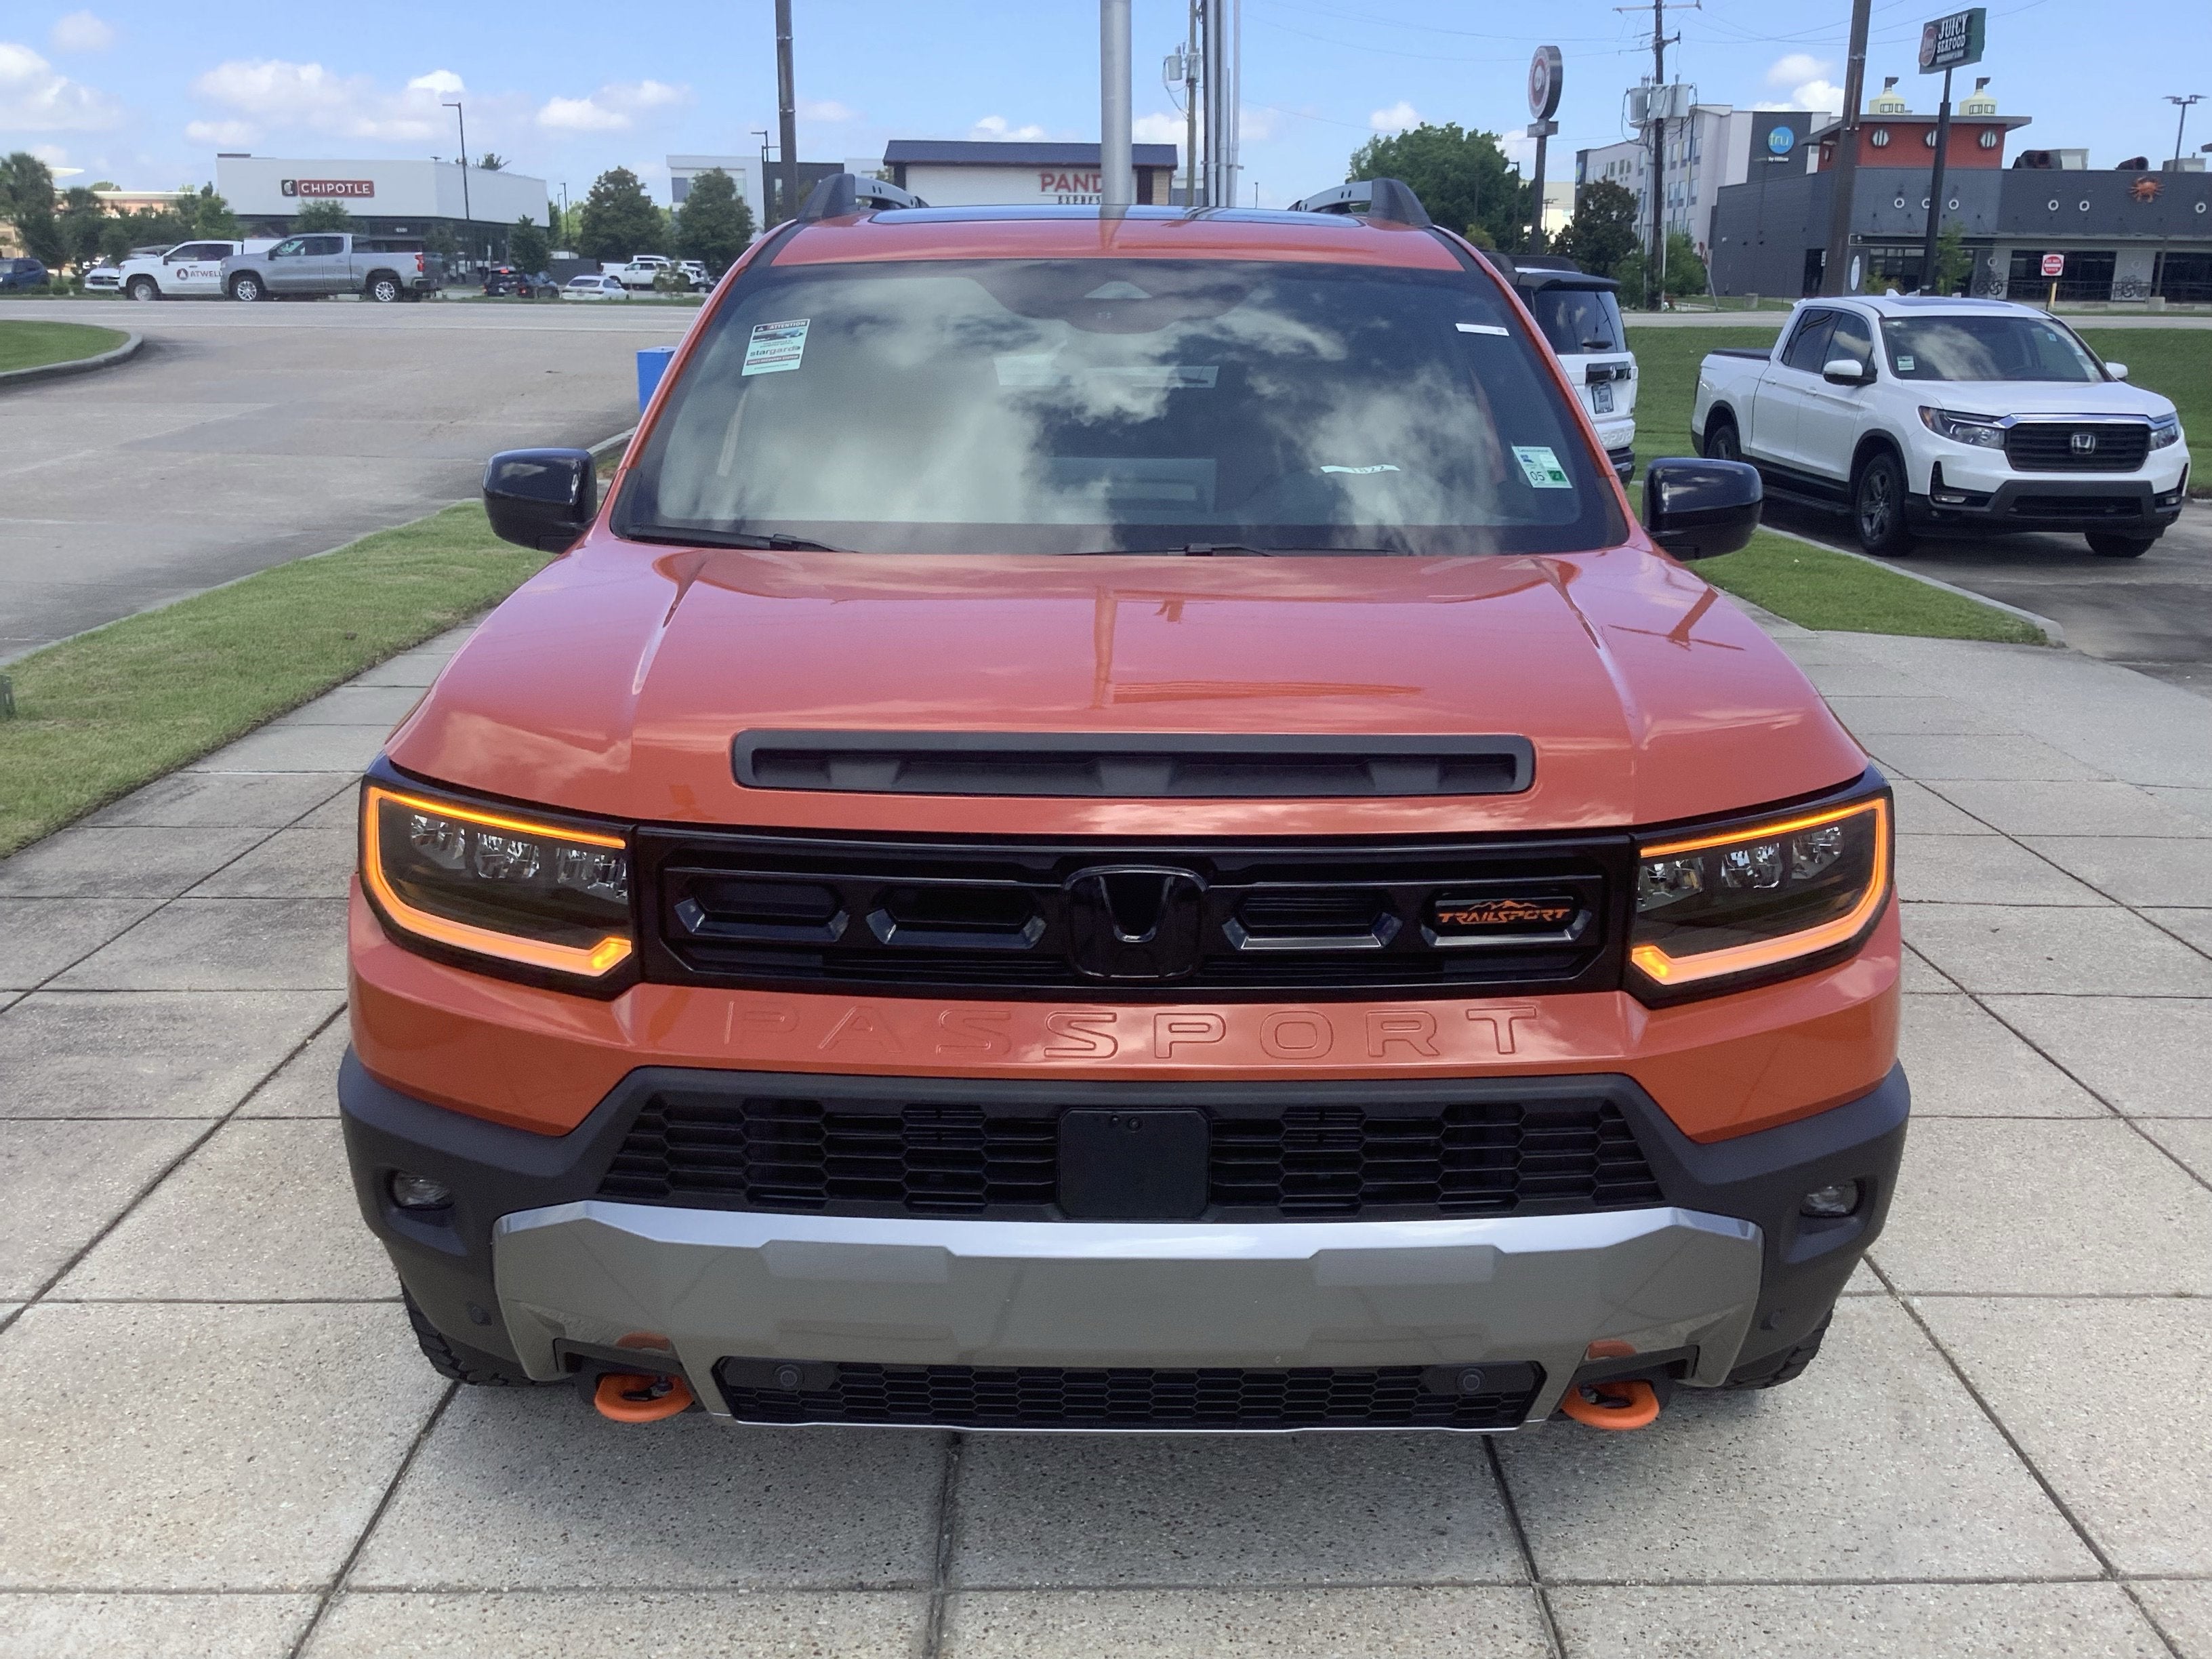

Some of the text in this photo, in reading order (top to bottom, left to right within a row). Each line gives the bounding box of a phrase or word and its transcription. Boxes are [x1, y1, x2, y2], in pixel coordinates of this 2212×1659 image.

[1938, 14, 1969, 41] JUICY
[1937, 35, 1966, 54] SEAFOOD
[1769, 132, 1789, 146] tru
[301, 183, 371, 194] CHIPOTLE
[1039, 173, 1102, 193] PAND
[1057, 195, 1101, 205] EXPRES
[769, 321, 806, 330] ATTENTION
[1530, 471, 1545, 481] 05
[1438, 909, 1571, 924] TRAILSPORT
[724, 1000, 1538, 1060] PASSPORT
